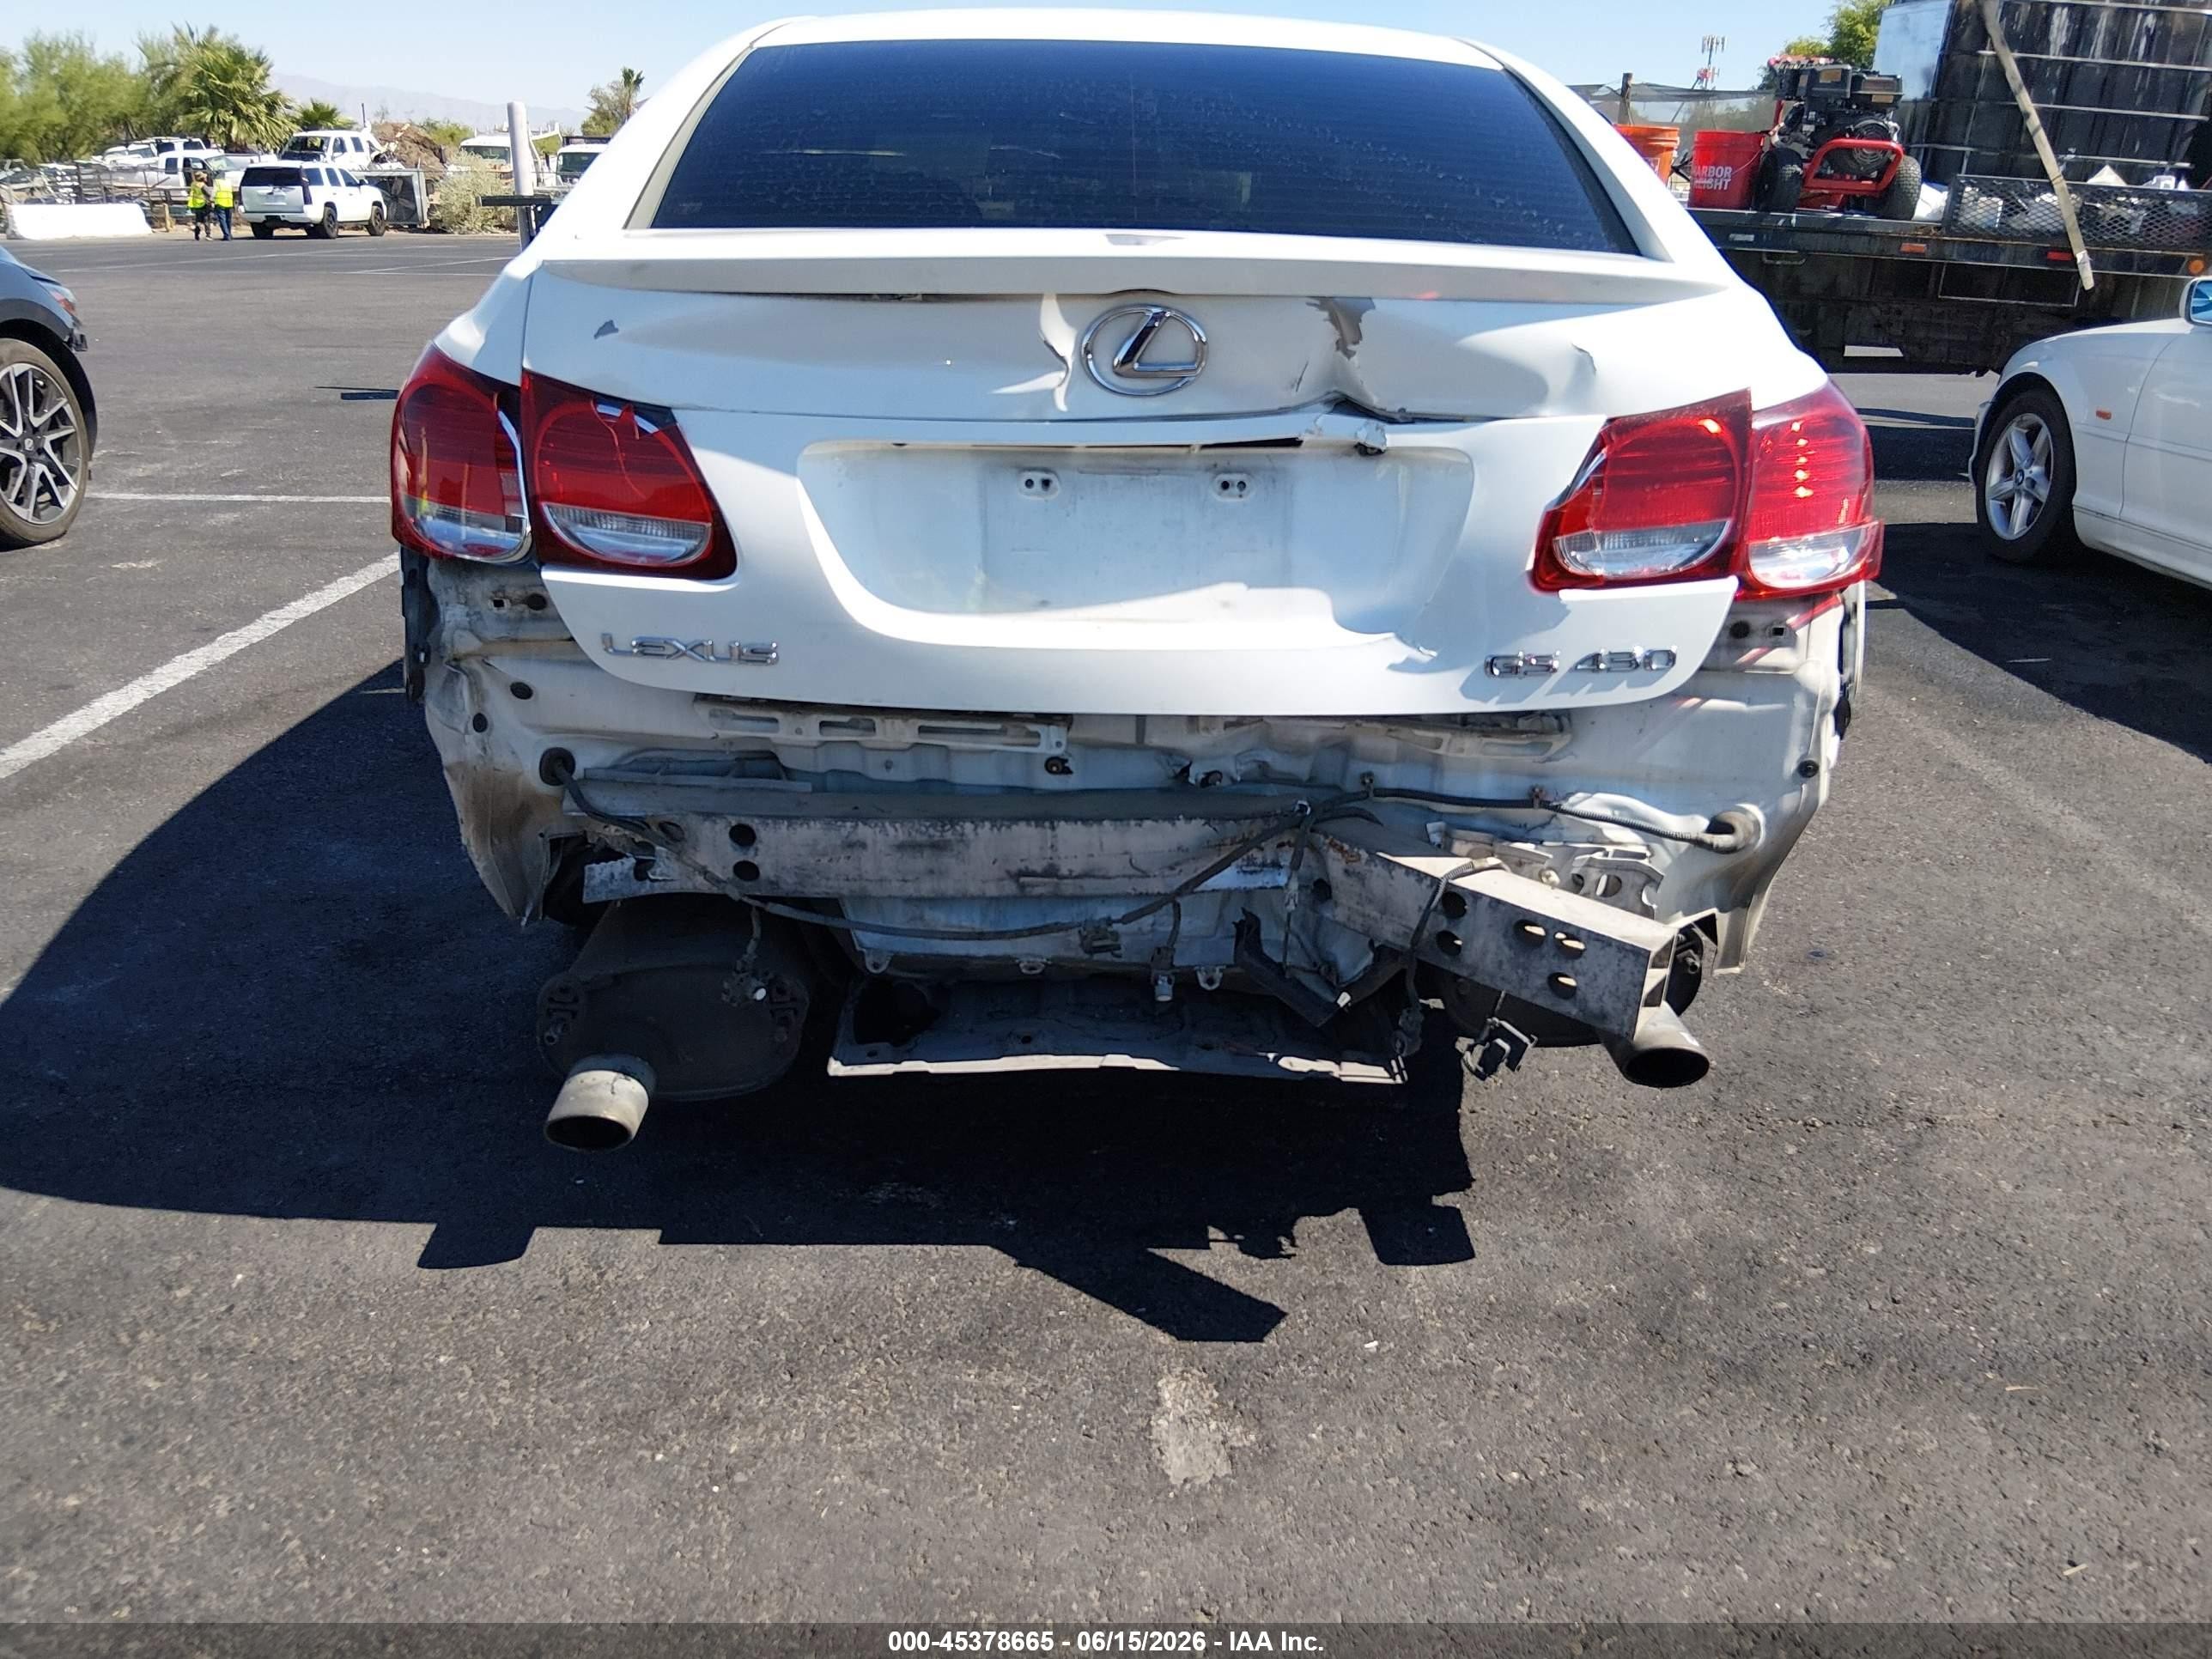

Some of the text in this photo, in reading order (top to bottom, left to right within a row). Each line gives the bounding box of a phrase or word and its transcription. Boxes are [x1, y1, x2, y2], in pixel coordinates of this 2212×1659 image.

[1693, 165, 1733, 179] ARBOR
[602, 633, 779, 665] LEXUS
[1484, 647, 1677, 679] GS 430
